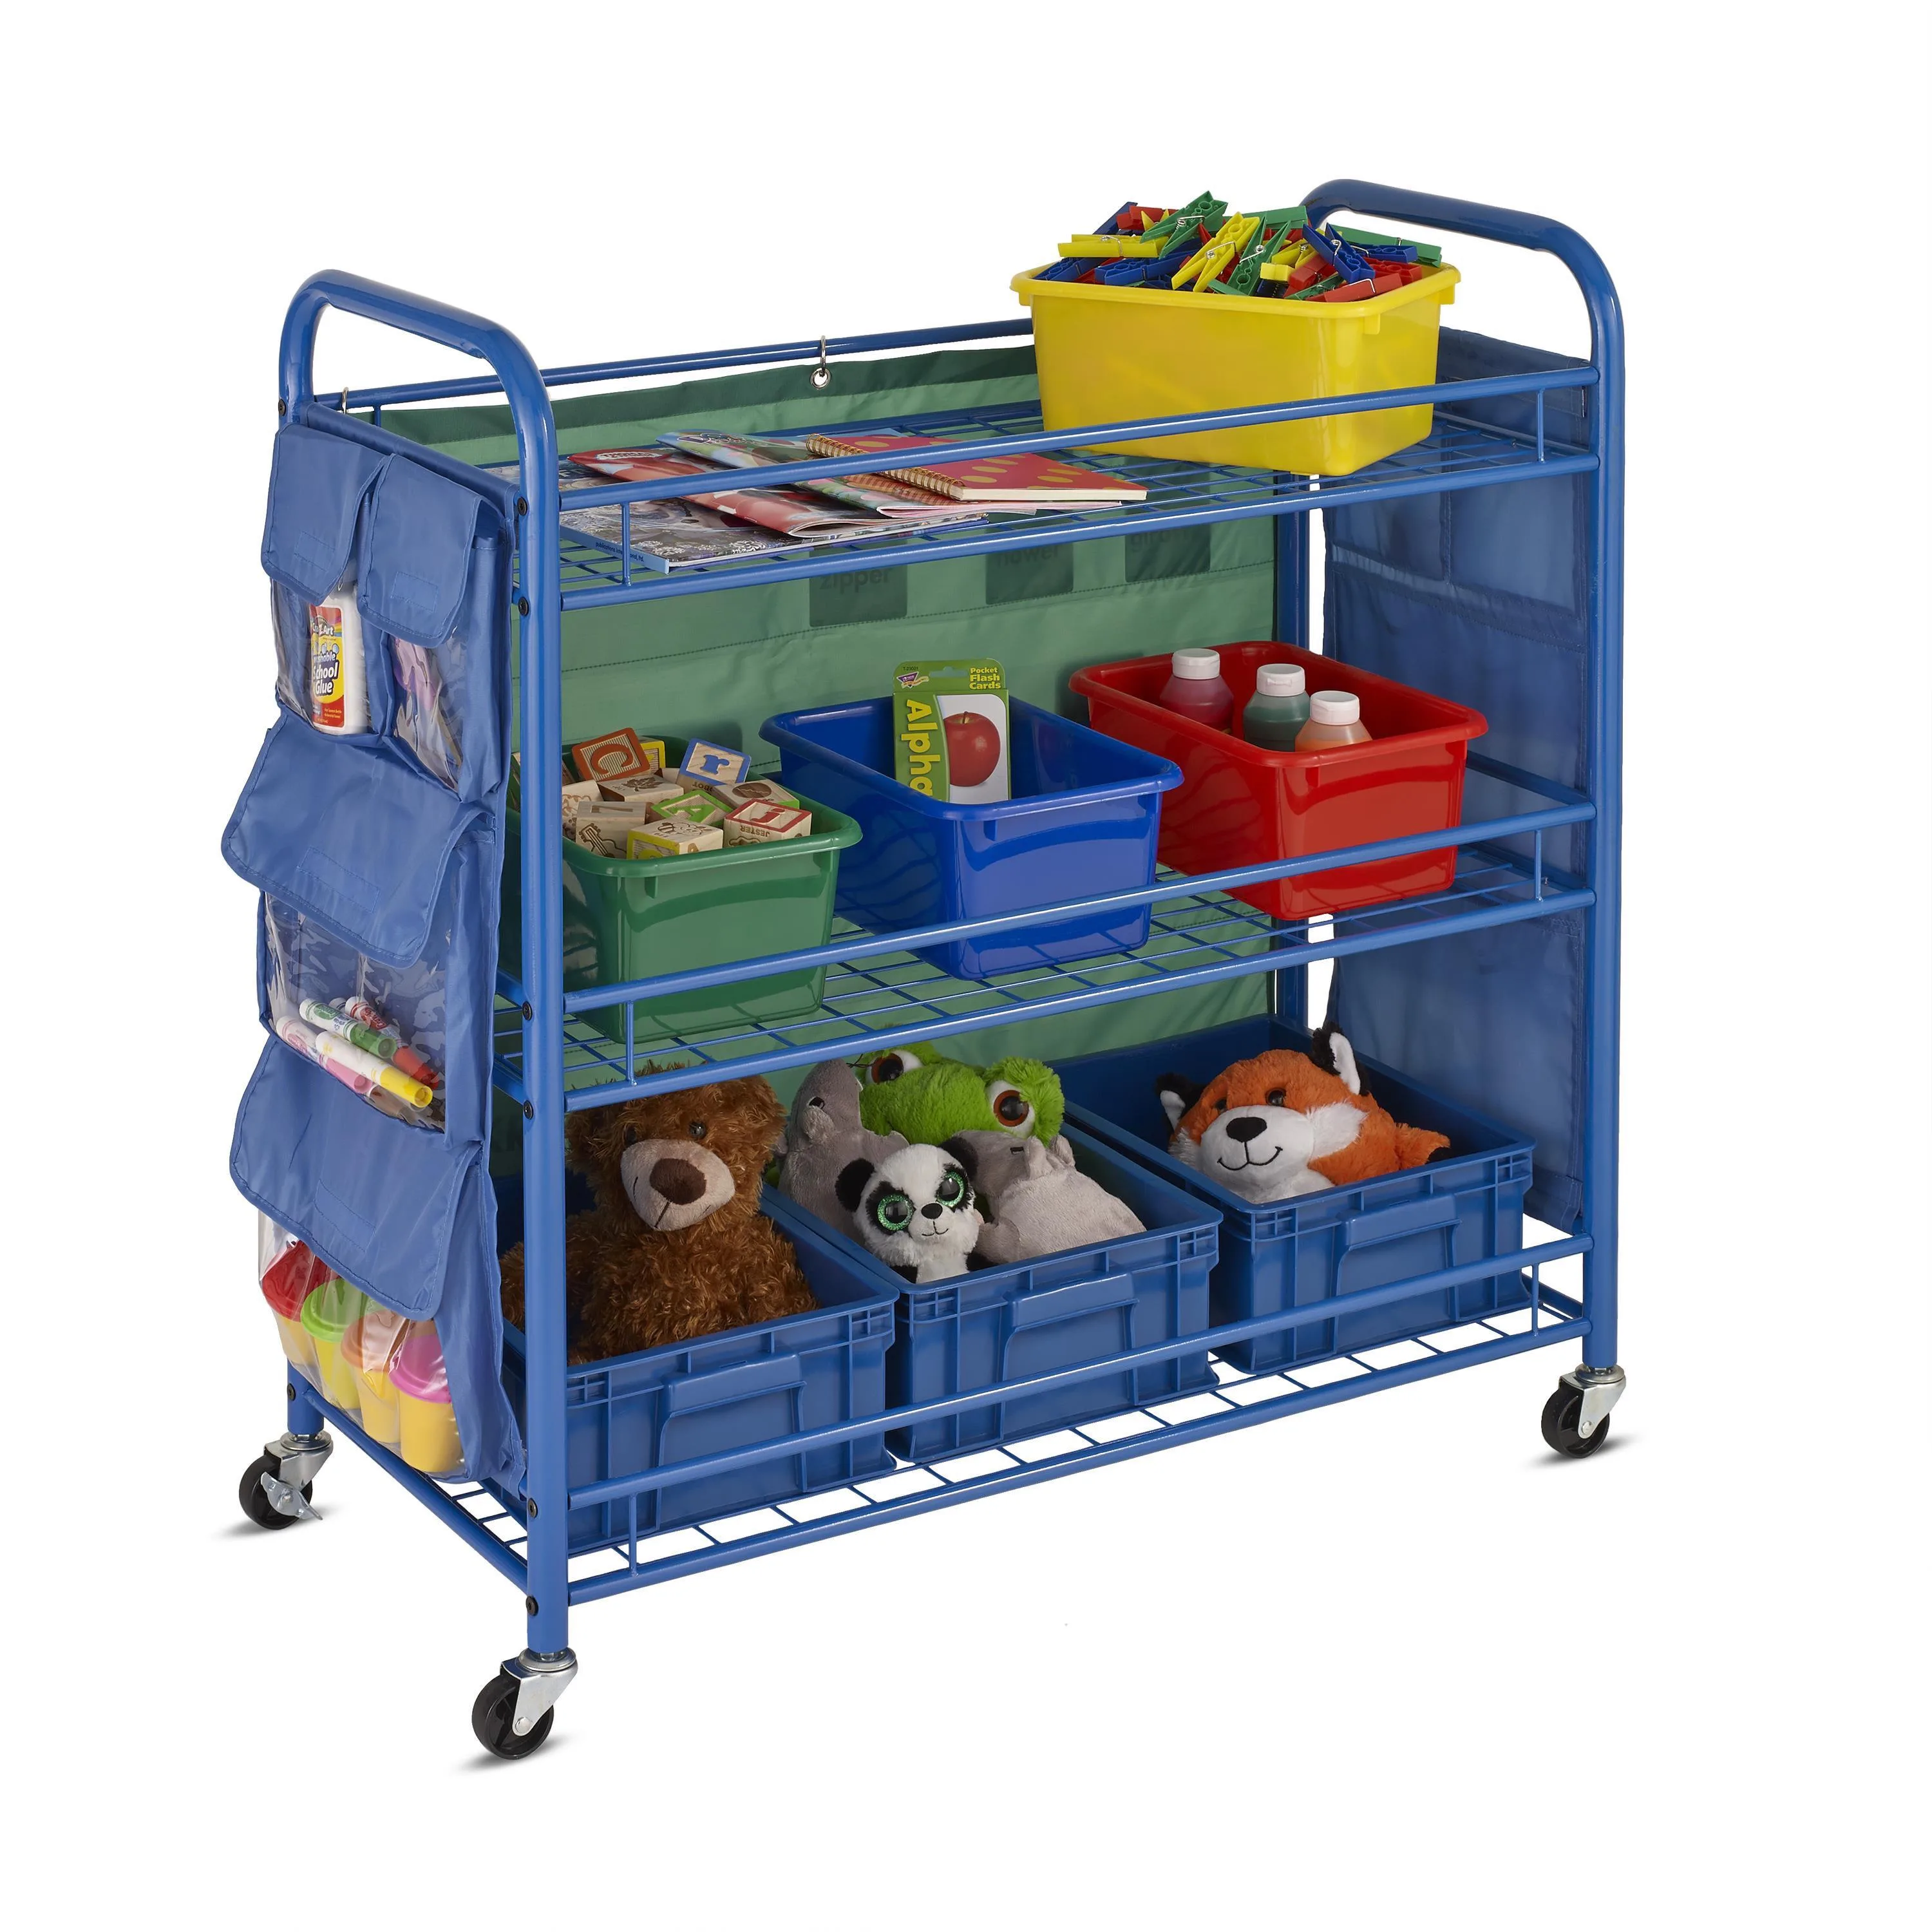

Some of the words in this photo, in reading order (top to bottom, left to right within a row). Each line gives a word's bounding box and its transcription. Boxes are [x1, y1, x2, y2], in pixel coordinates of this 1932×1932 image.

[313, 661, 339, 679] School
[969, 681, 1001, 690] Cards
[970, 674, 1000, 682] Flash
[315, 679, 333, 695] Glue
[591, 743, 634, 775] C
[740, 824, 770, 838] JESTER
